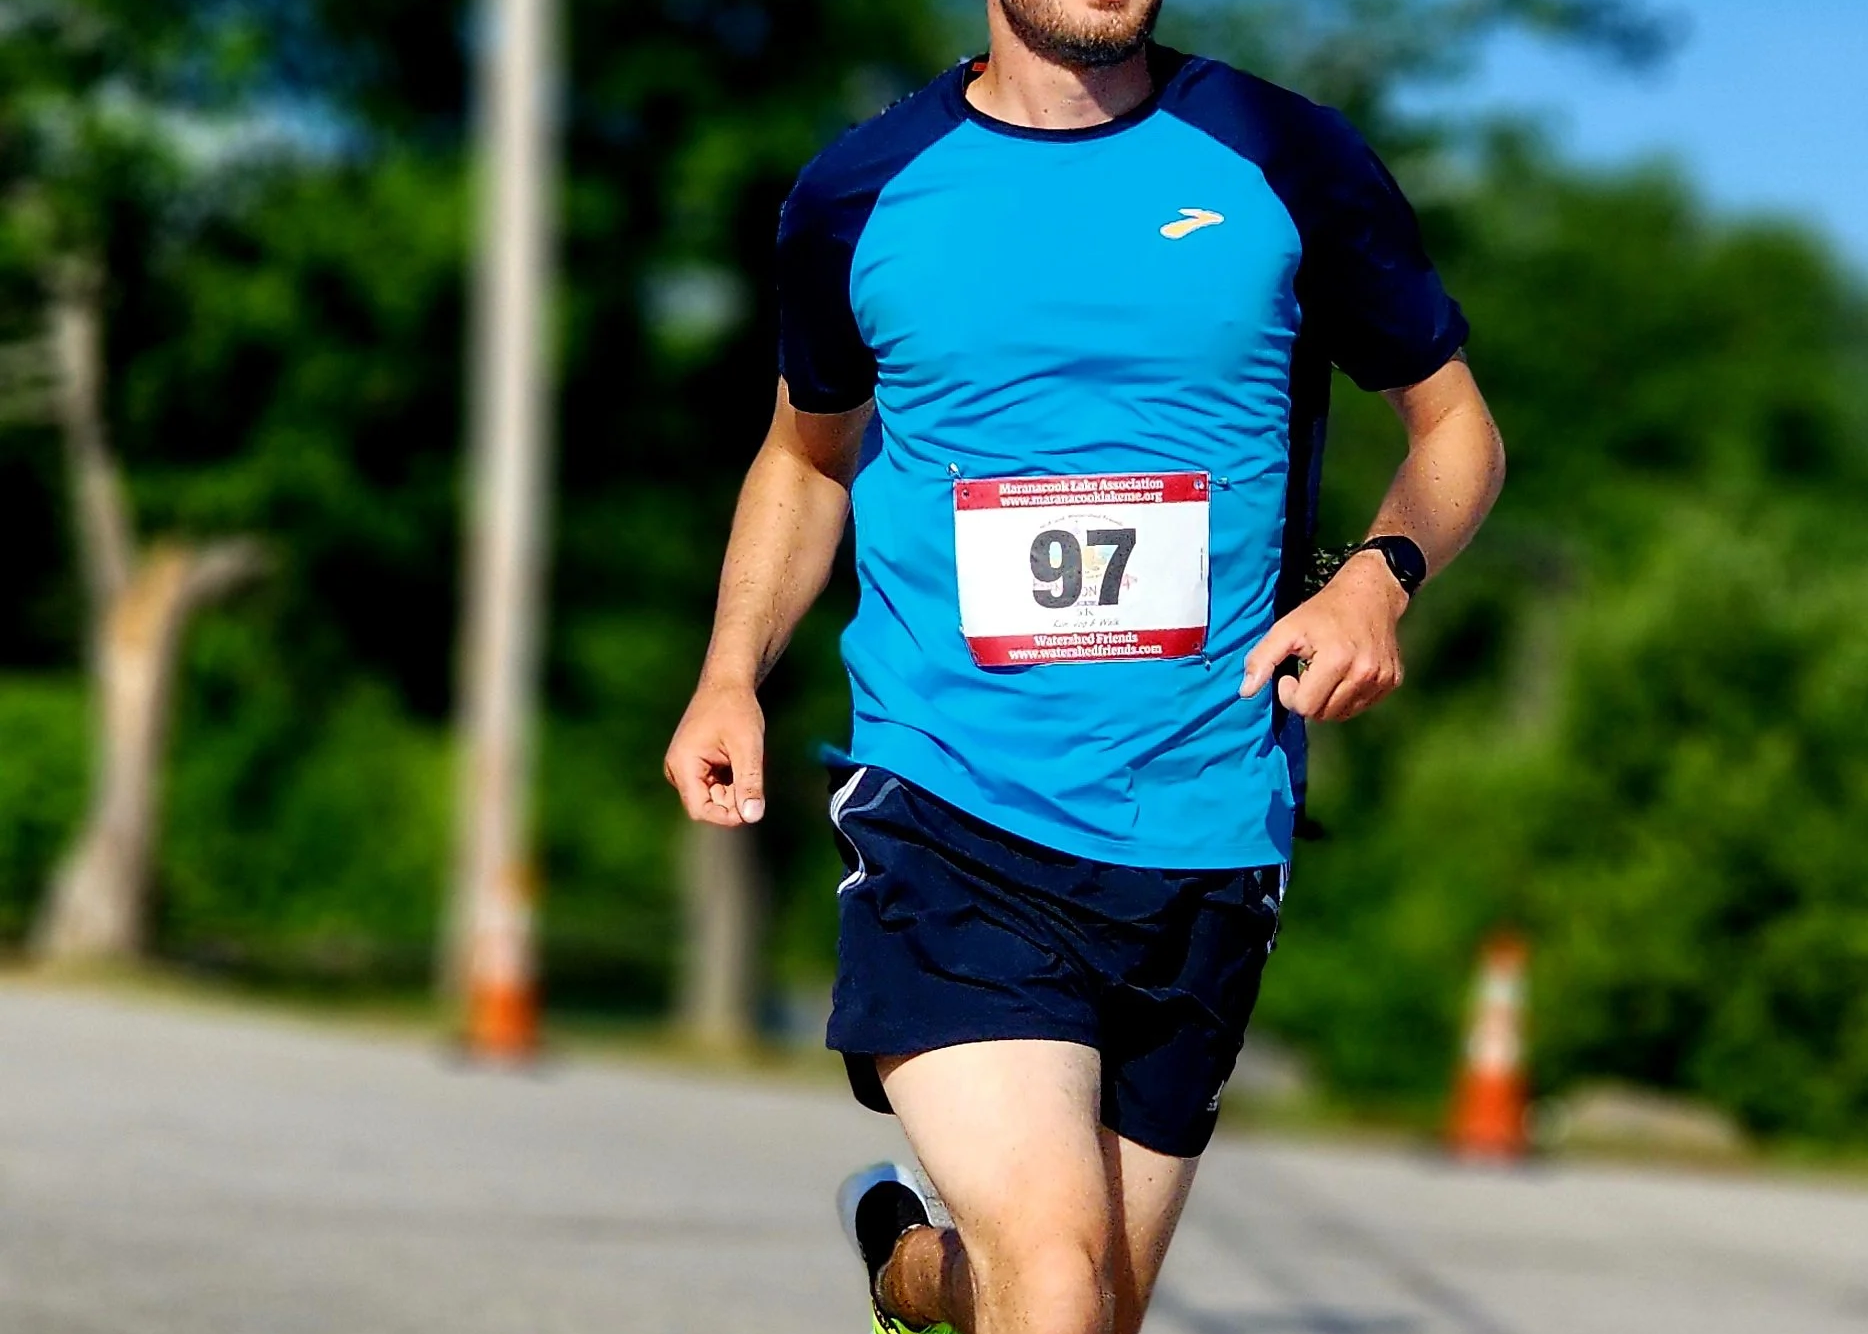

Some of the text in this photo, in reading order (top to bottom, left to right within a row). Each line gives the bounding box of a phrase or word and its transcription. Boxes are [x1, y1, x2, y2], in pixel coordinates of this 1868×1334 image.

[1071, 479, 1098, 492] Lake
[1099, 477, 1164, 491] Association
[1029, 528, 1137, 609] 97
[1033, 631, 1138, 648] Watershed Friends
[1008, 645, 1163, 660] www.watershedfriends.com
